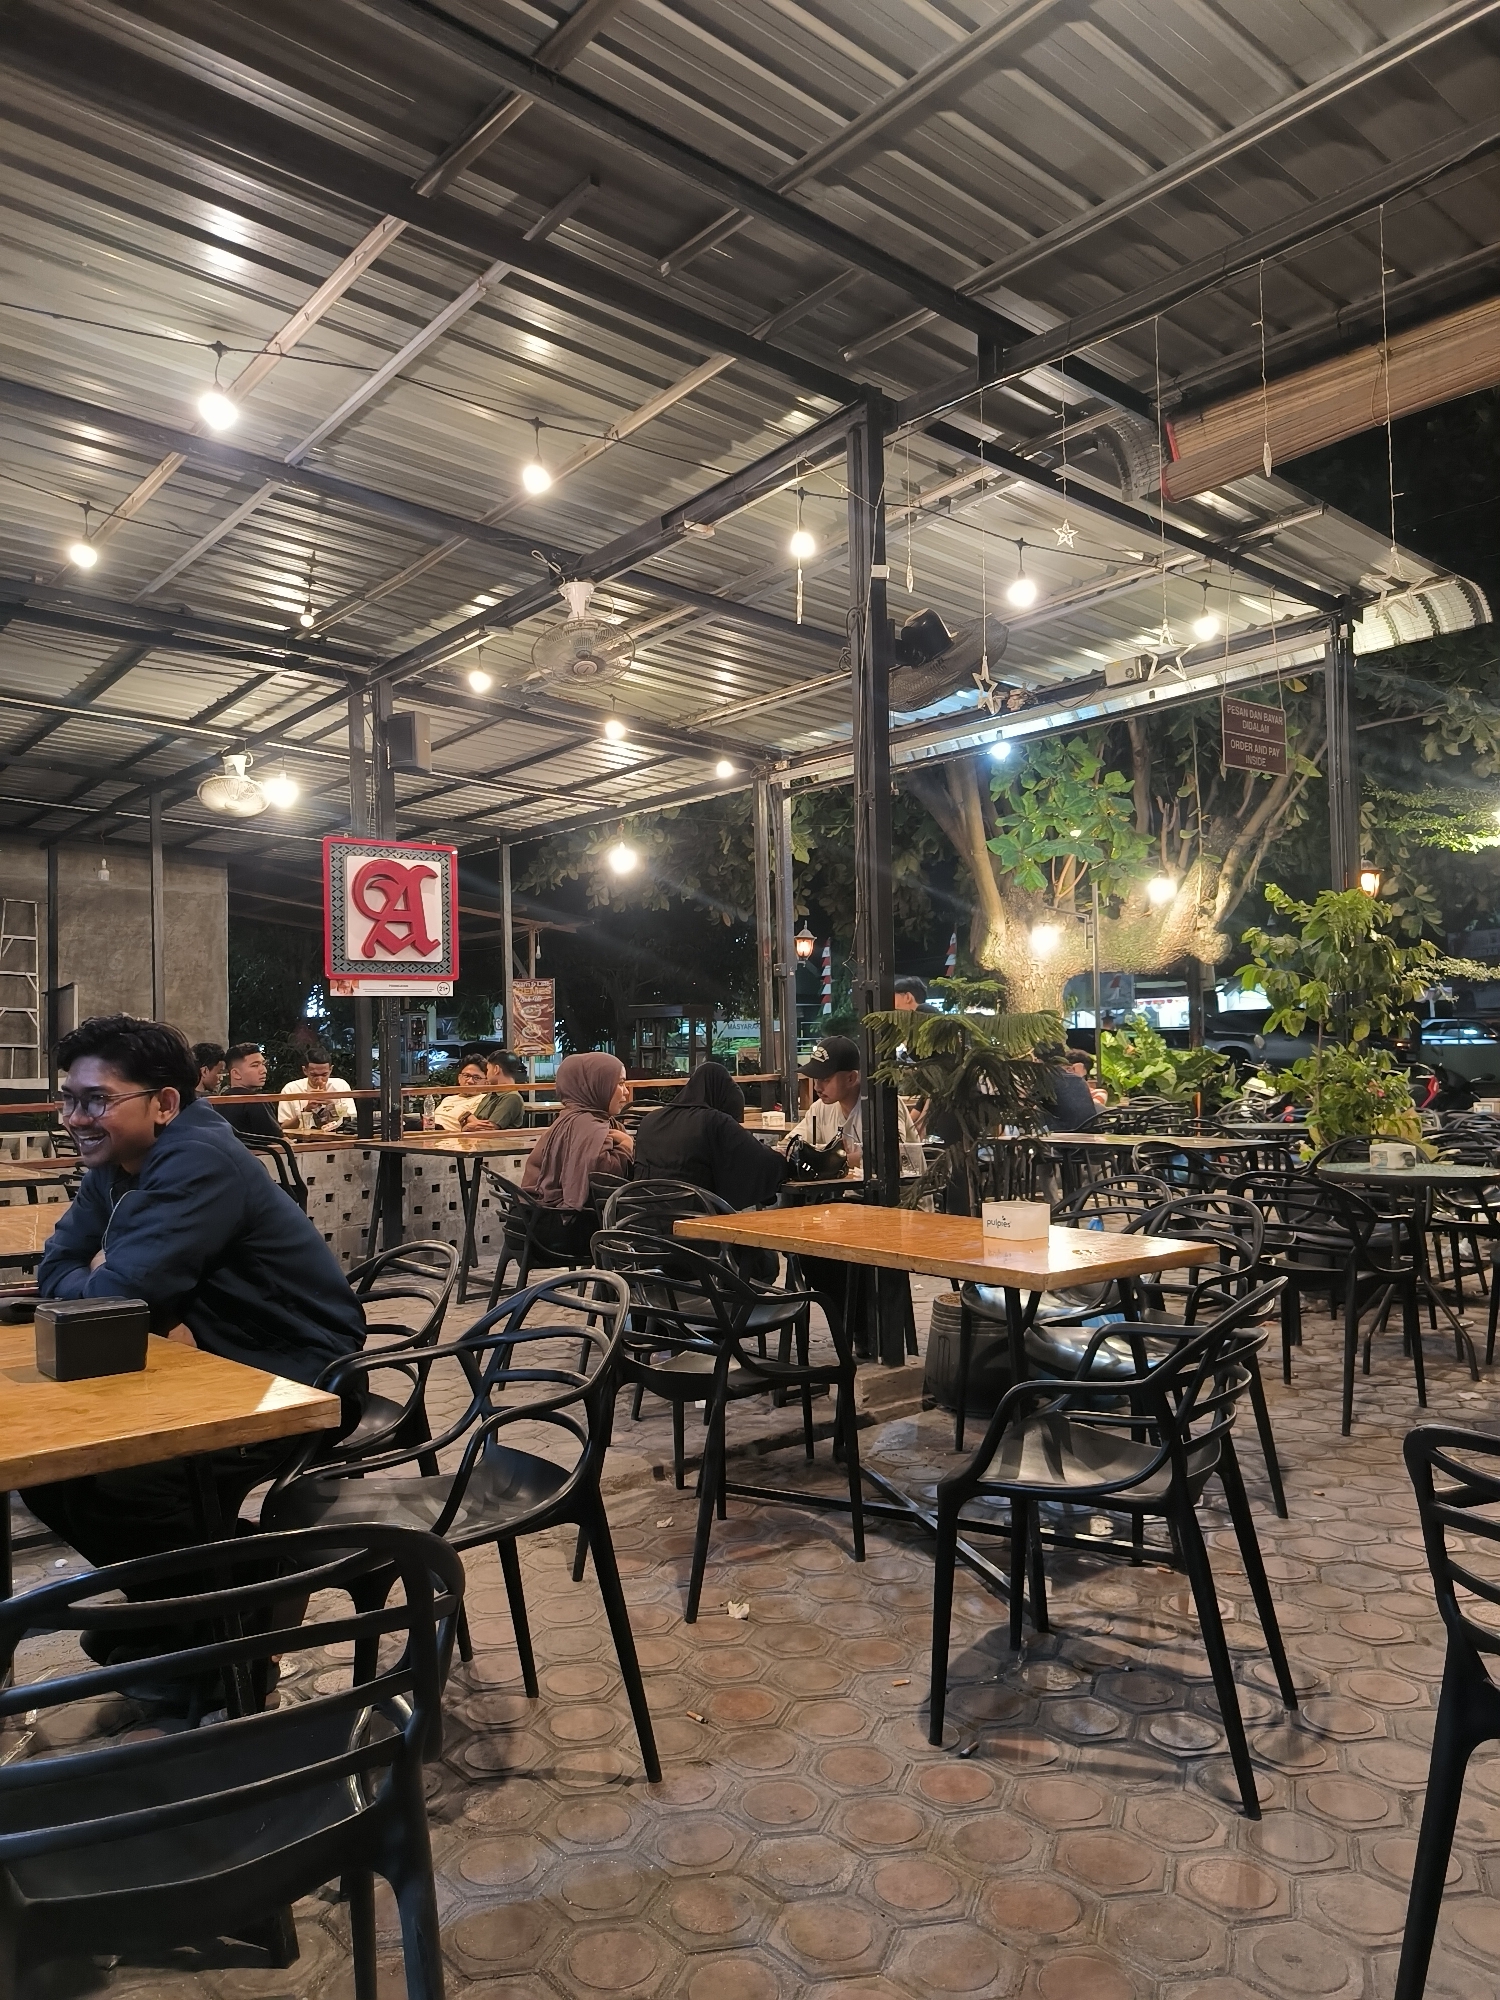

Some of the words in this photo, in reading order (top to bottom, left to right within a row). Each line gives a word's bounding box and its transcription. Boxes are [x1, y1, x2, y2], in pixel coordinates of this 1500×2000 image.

[1227, 704, 1248, 718] PESAN
[1250, 710, 1263, 720] DAN
[1264, 713, 1283, 726] BAYAR
[1242, 720, 1270, 734] DIDALAM
[1230, 739, 1253, 752] ORDER
[1254, 744, 1268, 755] AND
[1268, 747, 1280, 757] PAY
[1245, 754, 1267, 767] INSIDE
[351, 858, 442, 959] A
[986, 1217, 1010, 1228] pulpies
